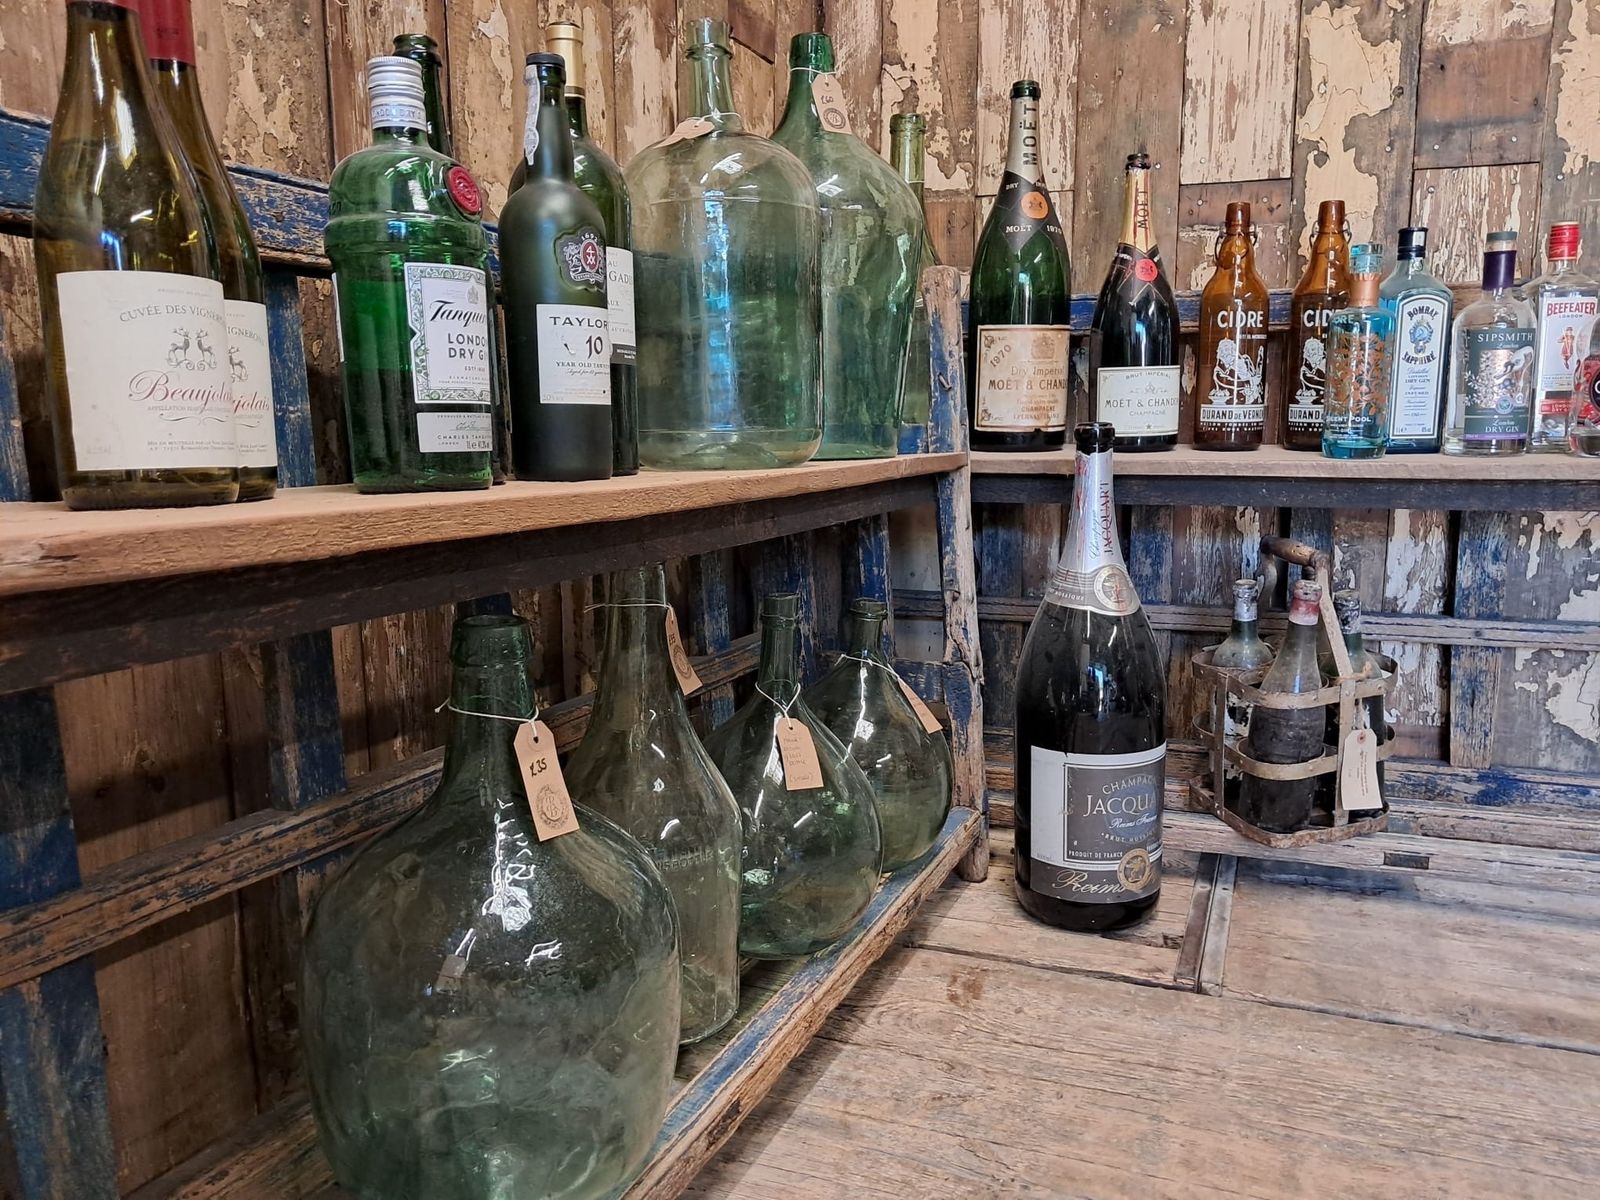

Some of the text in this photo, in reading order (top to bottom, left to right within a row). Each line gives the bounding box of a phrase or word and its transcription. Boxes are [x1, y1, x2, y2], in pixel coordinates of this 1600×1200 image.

[1019, 104, 1037, 166] MOËT
[580, 232, 598, 243] 1692
[119, 303, 224, 325] CUVÉE DES VIGNER
[1406, 305, 1439, 321] BOMBAY
[1546, 301, 1596, 317] BEEFEATER
[549, 316, 608, 330] TAYLOR
[1216, 310, 1264, 329] CIDRE
[447, 332, 486, 347] LONDO
[1477, 332, 1533, 343] SIPSMITH
[448, 347, 475, 360] DRY
[585, 334, 604, 359] 10
[990, 344, 1012, 367] 1970
[1401, 350, 1437, 365] SAPPHIRE
[578, 361, 592, 369] OLD
[128, 370, 232, 414] Beaujola
[1039, 379, 1067, 391] CHAND
[233, 391, 270, 415] jolais
[1137, 400, 1144, 408] &
[1147, 398, 1178, 408] CHAND
[1202, 408, 1234, 420] DURAND
[1234, 412, 1242, 420] DE
[1289, 409, 1321, 420] DURAND
[1350, 415, 1372, 423] POOL
[1485, 425, 1519, 433] DRY GIN
[1098, 480, 1114, 556] JACQUART
[1102, 775, 1157, 795] CHAMPAG
[1083, 792, 1156, 817] JACQUA
[1068, 850, 1093, 858] PRODUIT
[1103, 851, 1123, 859] FRANCE
[1051, 869, 1127, 894] Reims
